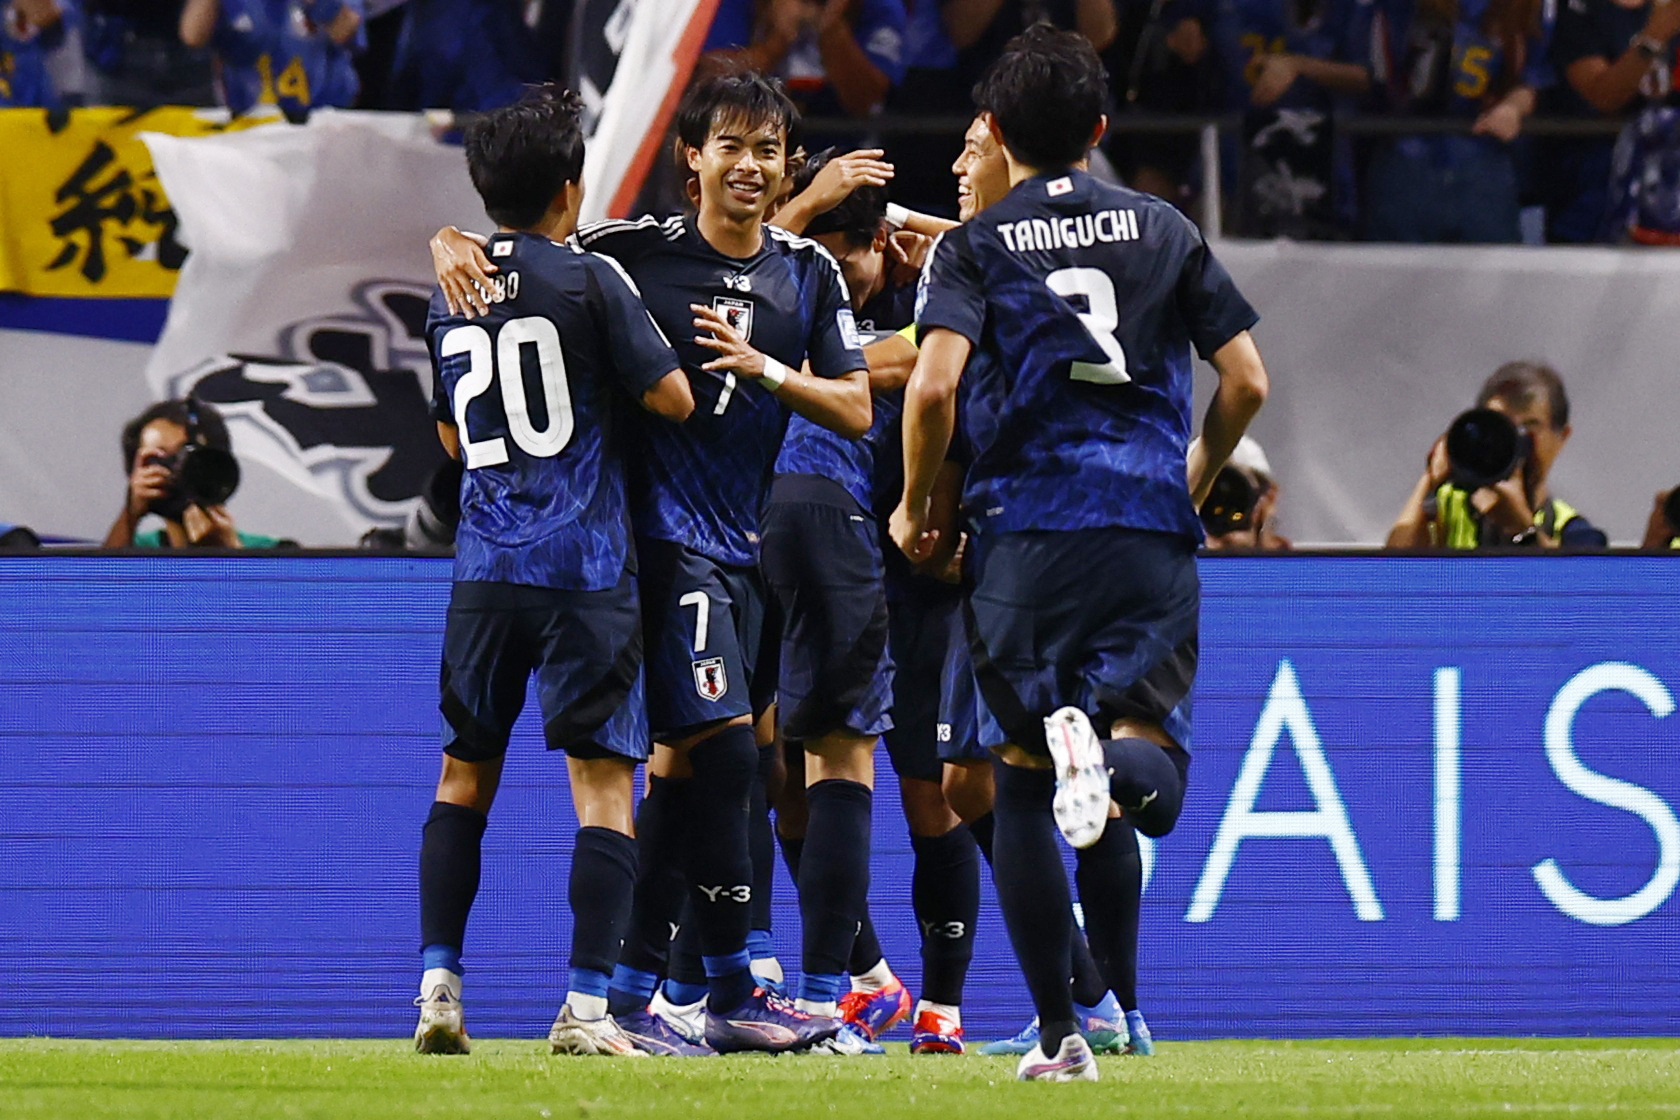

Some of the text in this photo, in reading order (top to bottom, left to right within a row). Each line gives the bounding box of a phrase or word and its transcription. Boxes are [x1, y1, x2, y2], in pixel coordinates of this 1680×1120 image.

[997, 208, 1139, 252] TANIGUCHI
[1044, 266, 1132, 385] 3
[441, 316, 575, 470] 20
[679, 590, 709, 652] 7
[698, 885, 751, 903] Y-3
[921, 920, 965, 938] Y-3
